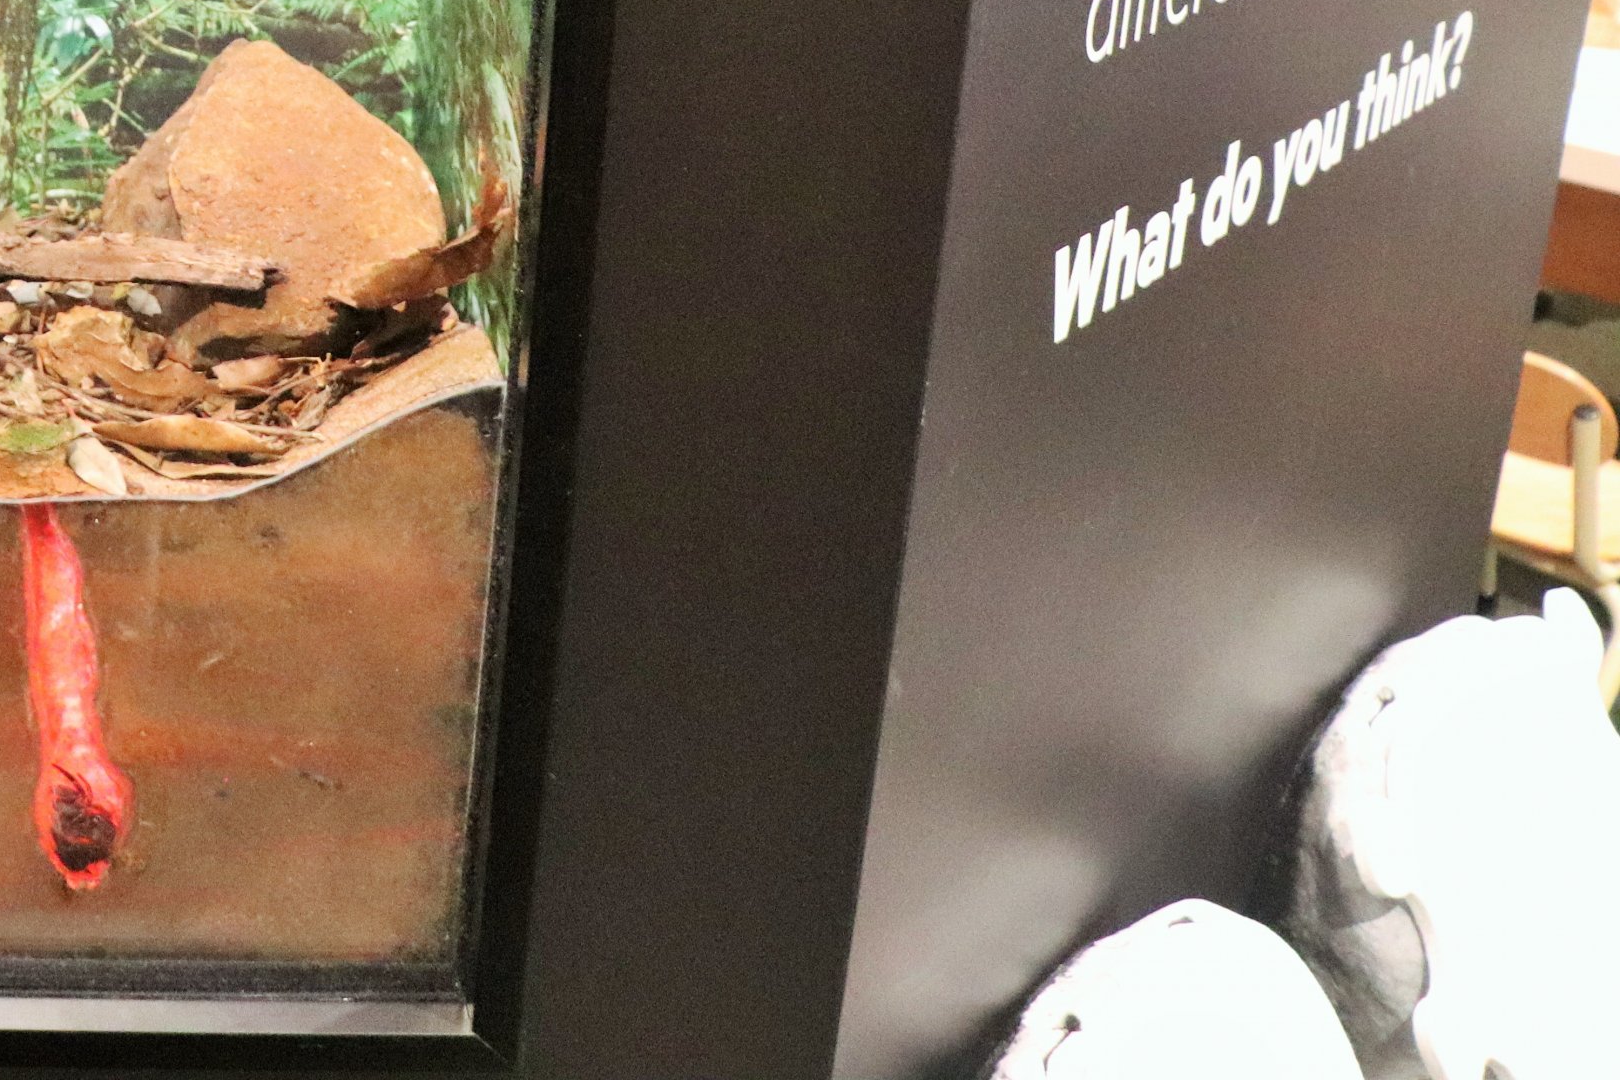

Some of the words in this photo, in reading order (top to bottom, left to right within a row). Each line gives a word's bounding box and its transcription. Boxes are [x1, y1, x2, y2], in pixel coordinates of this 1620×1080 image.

[1053, 176, 1197, 344] What
[1200, 139, 1264, 247] do
[1267, 99, 1351, 226] you
[1353, 9, 1474, 150] think?
